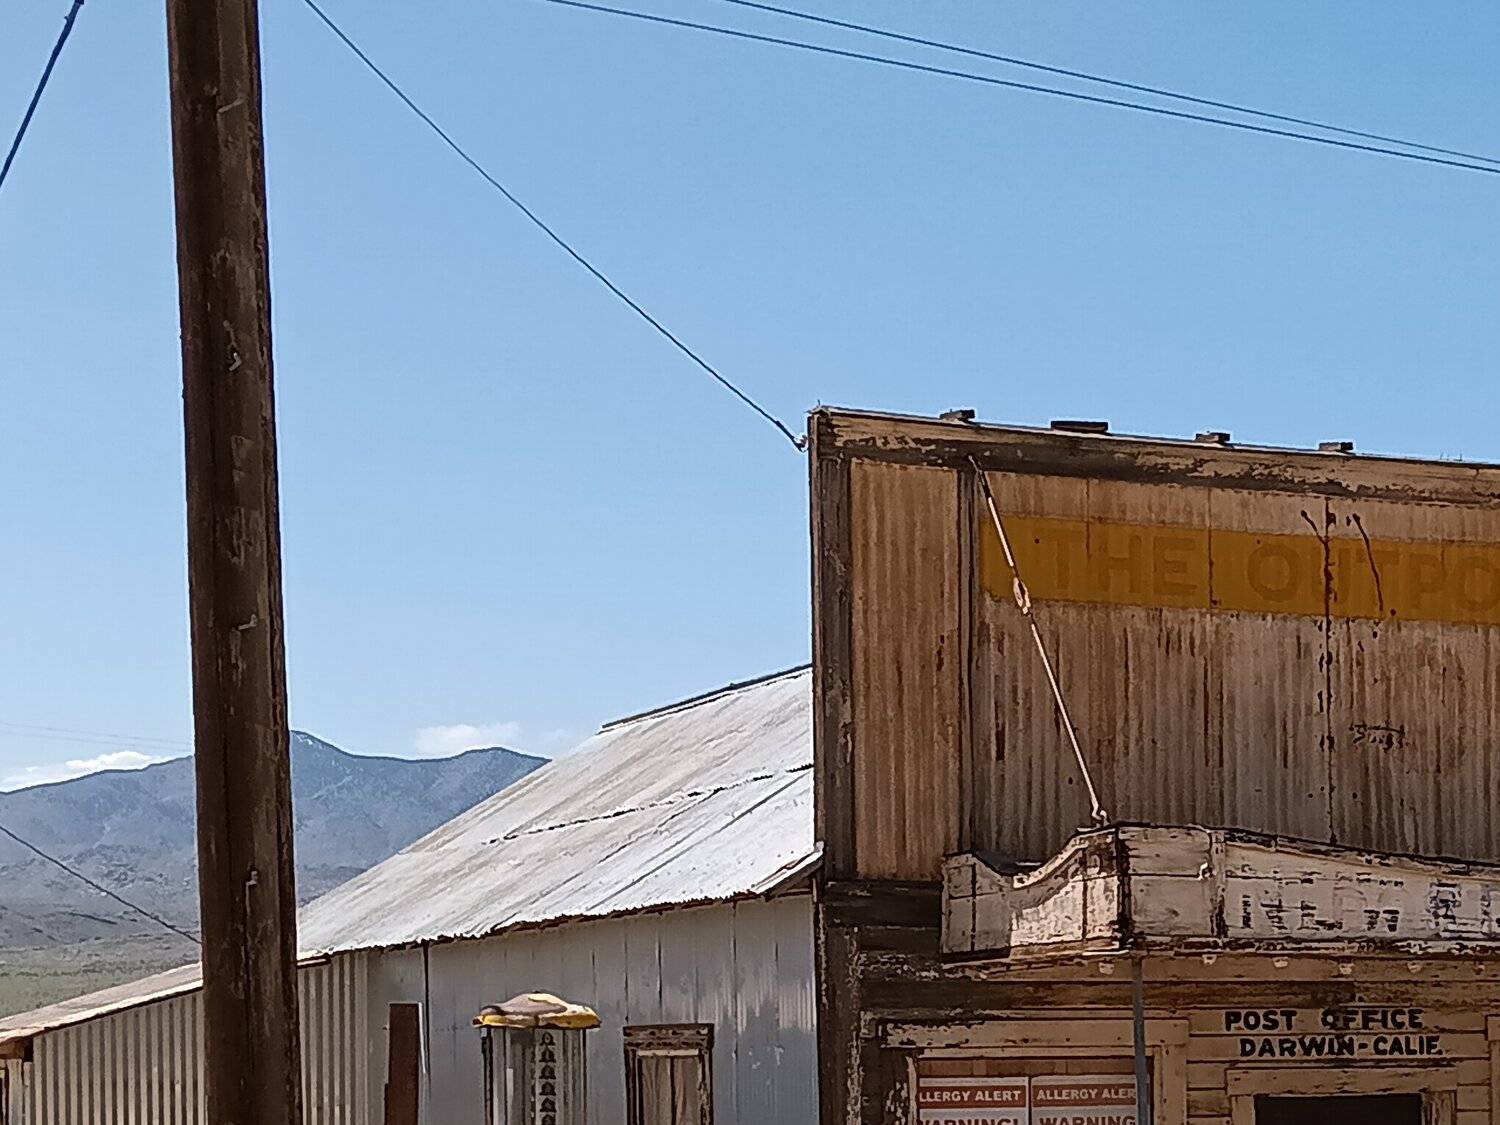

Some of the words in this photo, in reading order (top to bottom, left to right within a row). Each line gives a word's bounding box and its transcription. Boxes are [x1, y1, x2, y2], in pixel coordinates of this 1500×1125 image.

[1032, 528, 1198, 597] THE
[1224, 1009, 1298, 1031] POST
[1321, 1008, 1424, 1031] OFFICE
[919, 1090, 971, 1102] LLERGY
[975, 1090, 1021, 1102] ALERT
[1037, 1088, 1098, 1100] ALLERGY
[1102, 1088, 1137, 1099] ALER
